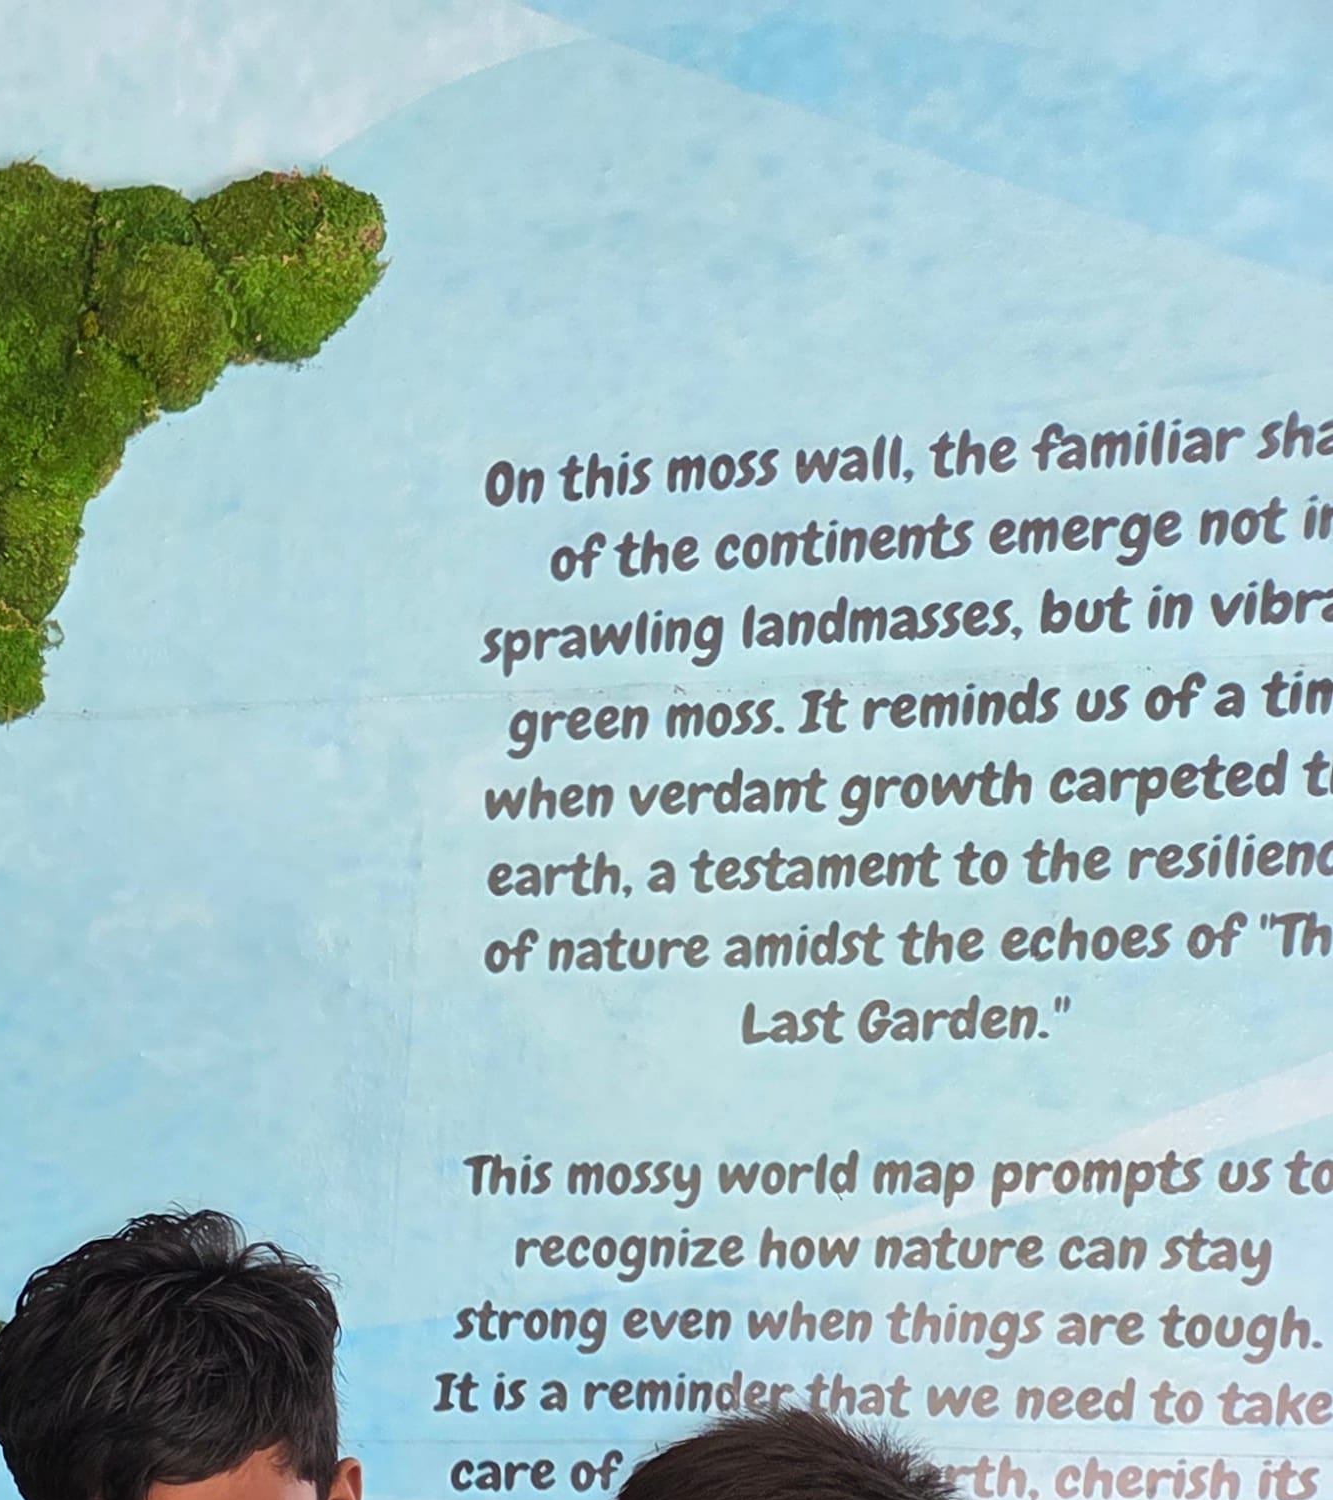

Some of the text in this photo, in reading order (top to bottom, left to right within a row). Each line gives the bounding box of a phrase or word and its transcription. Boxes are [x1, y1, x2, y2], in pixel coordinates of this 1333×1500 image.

[485, 461, 545, 507] On
[559, 453, 652, 503] this
[666, 451, 778, 490] moss
[795, 437, 914, 484] wall,
[929, 431, 1014, 480] the
[1029, 424, 1241, 473] familiar
[551, 532, 606, 580] of
[618, 531, 697, 577] the
[714, 514, 970, 569] continents
[986, 511, 1178, 567] emerge
[1197, 499, 1282, 545] not
[484, 613, 722, 674] sprawling
[742, 597, 1020, 647] landmasses,
[1039, 587, 1129, 634] but
[1147, 583, 1192, 630] in
[509, 705, 649, 759] green
[668, 698, 785, 737] moss.
[800, 687, 846, 734] It
[861, 677, 1059, 729] reminds
[1075, 686, 1126, 723] us
[1142, 672, 1205, 721] of
[1214, 683, 1243, 718] a
[483, 751, 1333, 828] when verdant growth carpeted t
[488, 852, 633, 897] earth,
[649, 860, 677, 895] a
[692, 843, 940, 895] testament
[955, 842, 1009, 887] to
[1024, 839, 1109, 885] the
[484, 928, 539, 973] of
[548, 930, 710, 971] nature
[724, 921, 884, 968] amidst
[900, 920, 985, 966] the
[999, 915, 1170, 961] echoes
[1187, 911, 1246, 959] of
[740, 994, 1069, 1045] Last Garden."
[467, 1148, 1333, 1211] This mossy world map prompts us to
[516, 1226, 1273, 1289] recognize how nature can stay
[457, 1300, 1323, 1366] strong even when things are tough.
[433, 1369, 1333, 1427] It is a reminder that we need to take
[452, 1459, 553, 1489] care
[571, 1451, 622, 1489] of
